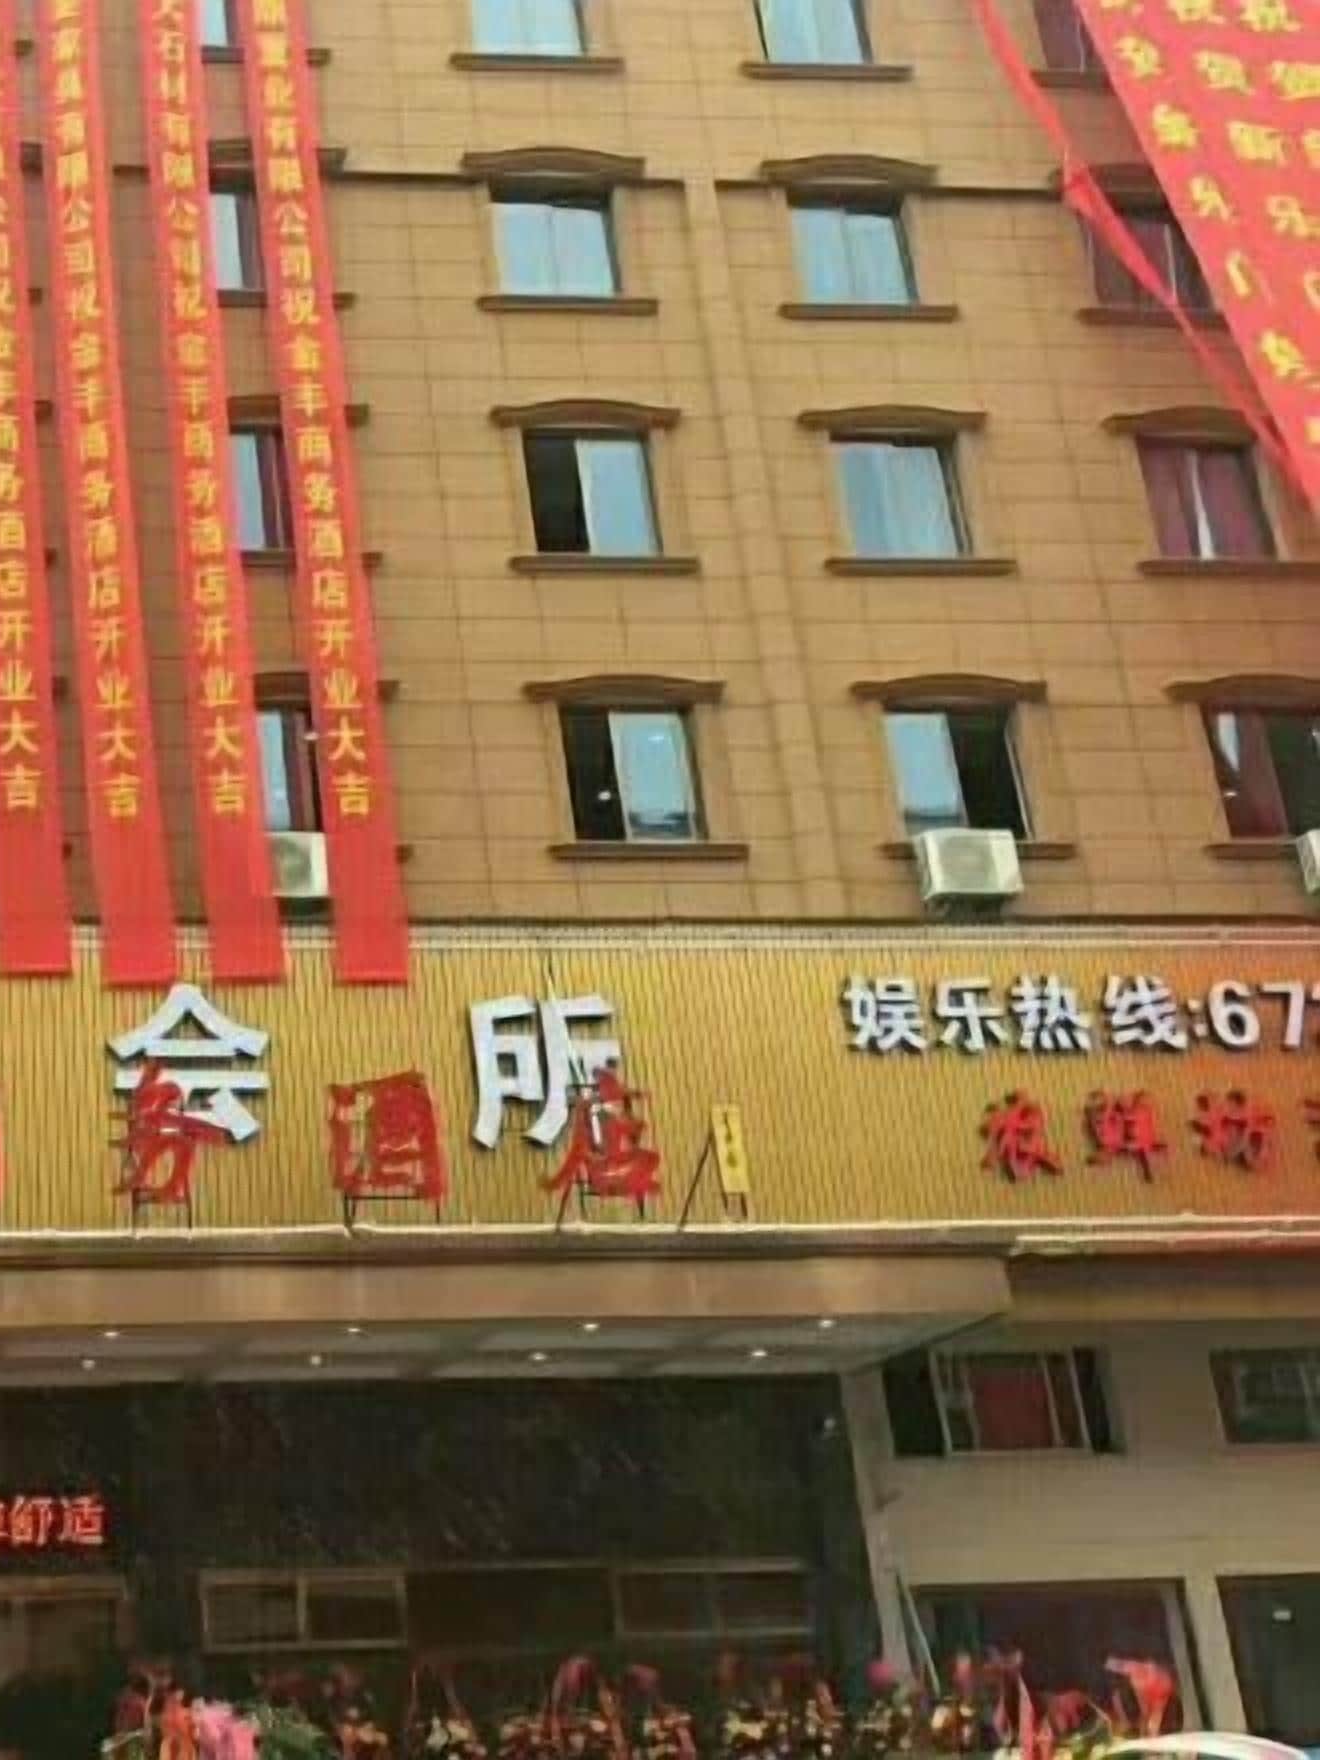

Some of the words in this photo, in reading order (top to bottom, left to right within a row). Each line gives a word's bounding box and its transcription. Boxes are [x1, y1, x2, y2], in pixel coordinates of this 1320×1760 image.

[48, 0, 139, 816] 有限公司祝金丰商务酒店开业大吉
[253, 0, 368, 814] 有限公司祝金丰商务酒店开业大吉
[843, 973, 1320, 1052] 娱乐热线:67
